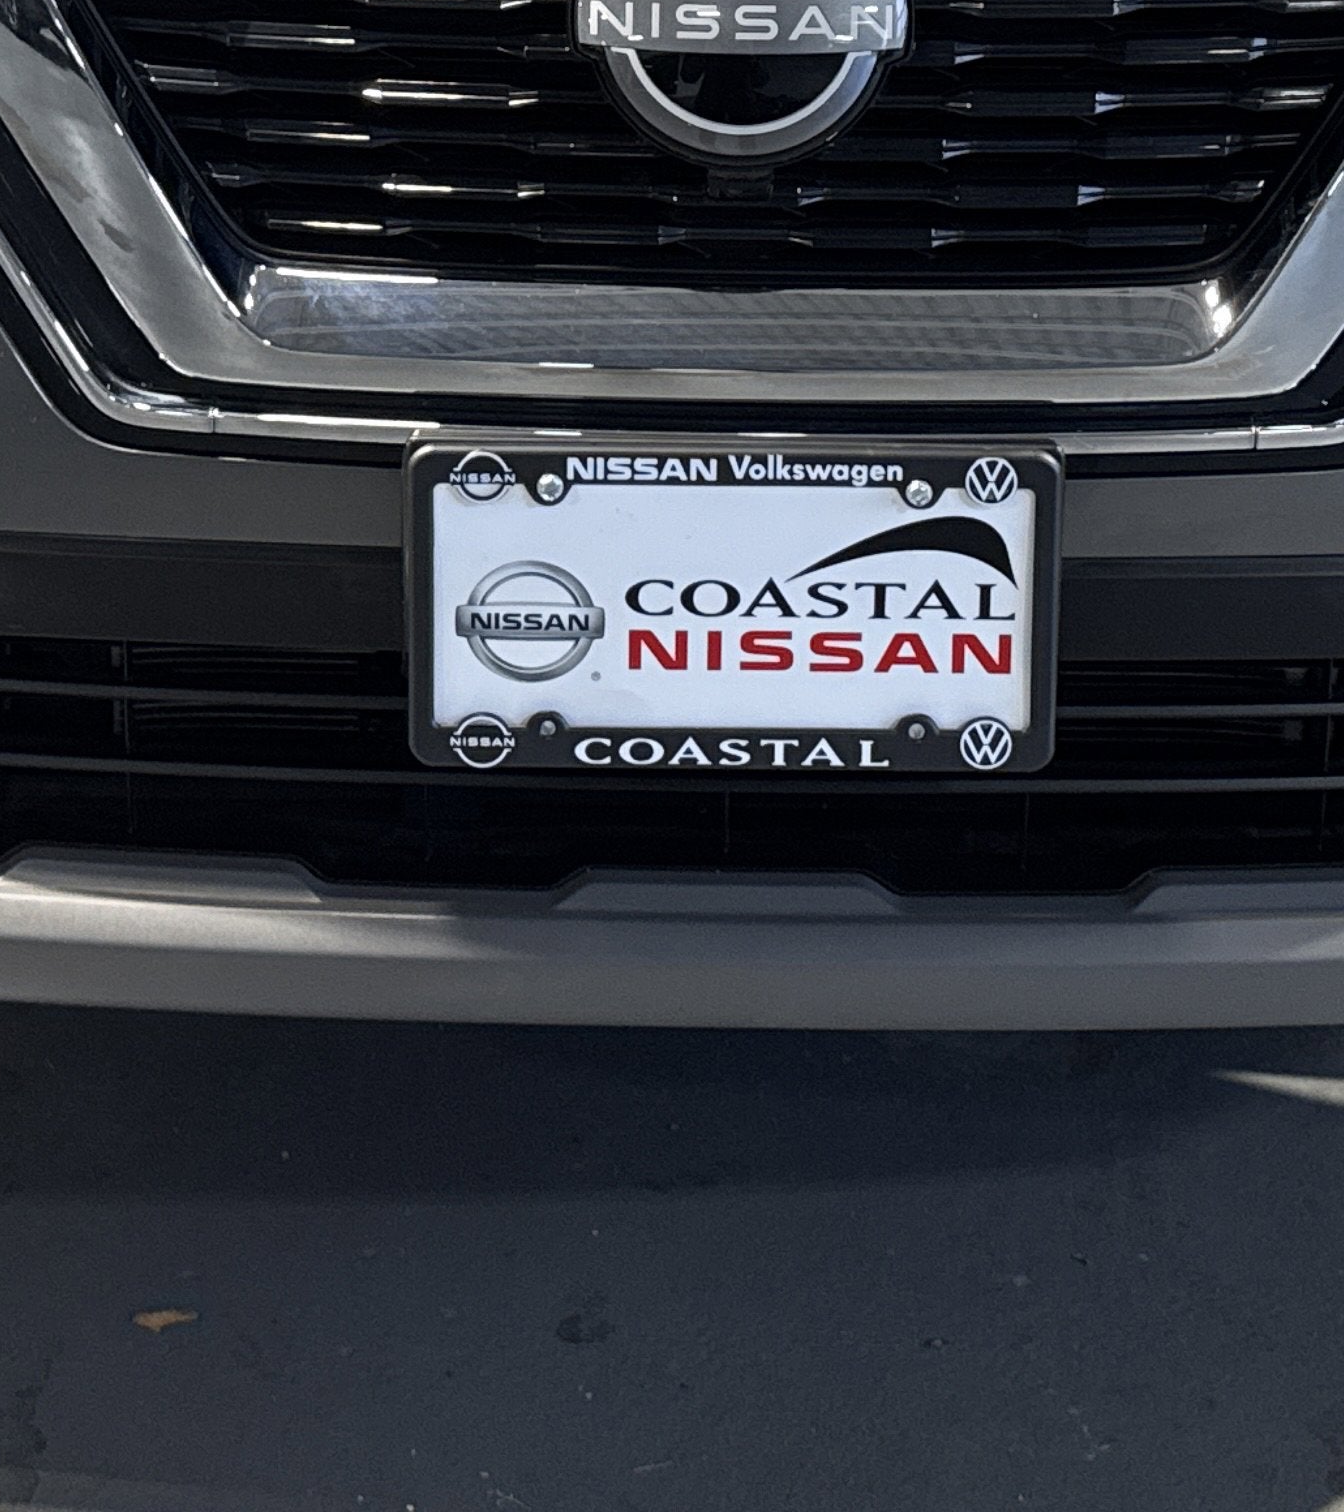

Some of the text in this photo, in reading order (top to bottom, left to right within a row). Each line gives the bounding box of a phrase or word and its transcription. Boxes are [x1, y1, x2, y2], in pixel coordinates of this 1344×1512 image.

[589, 0, 894, 41] NISSAN
[449, 472, 516, 483] NISSAN
[566, 454, 904, 486] NISSAN Volkswagen
[624, 577, 1017, 621] COASTAL
[469, 611, 591, 633] NISSAN
[627, 629, 1013, 675] NISSAN
[449, 737, 516, 748] NISSAN
[574, 736, 891, 769] COASTAL
